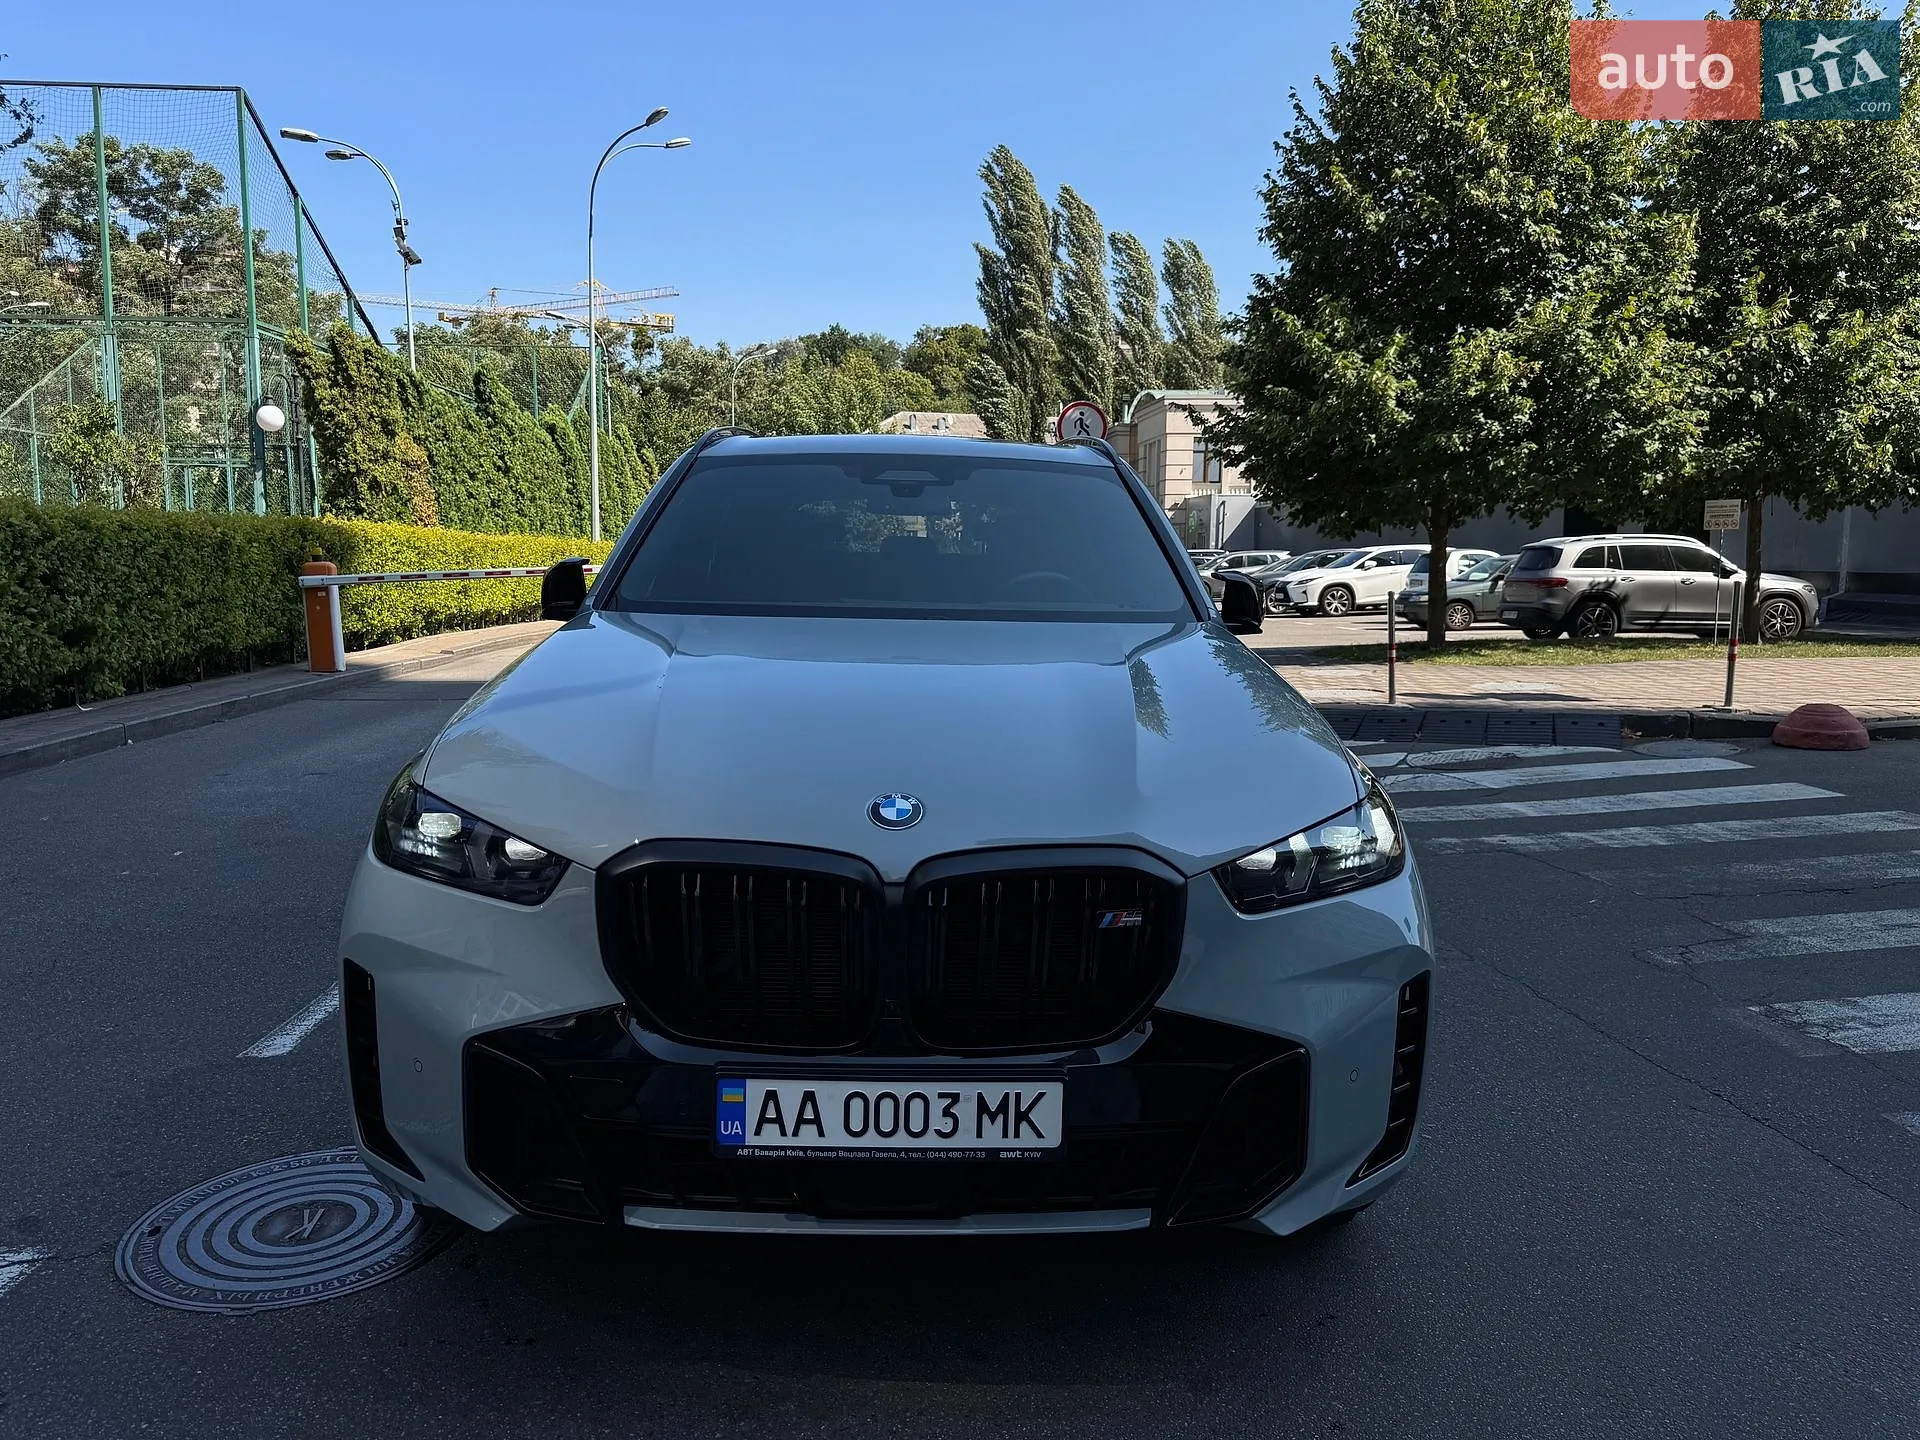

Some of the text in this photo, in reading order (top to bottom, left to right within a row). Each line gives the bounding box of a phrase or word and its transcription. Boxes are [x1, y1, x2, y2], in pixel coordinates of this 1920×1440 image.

[753, 1087, 1048, 1140] AA 0003 MK
[720, 1121, 743, 1136] UA
[754, 1149, 785, 1157] Баварія
[807, 1150, 837, 1158] бульвар
[999, 1150, 1022, 1158] awt
